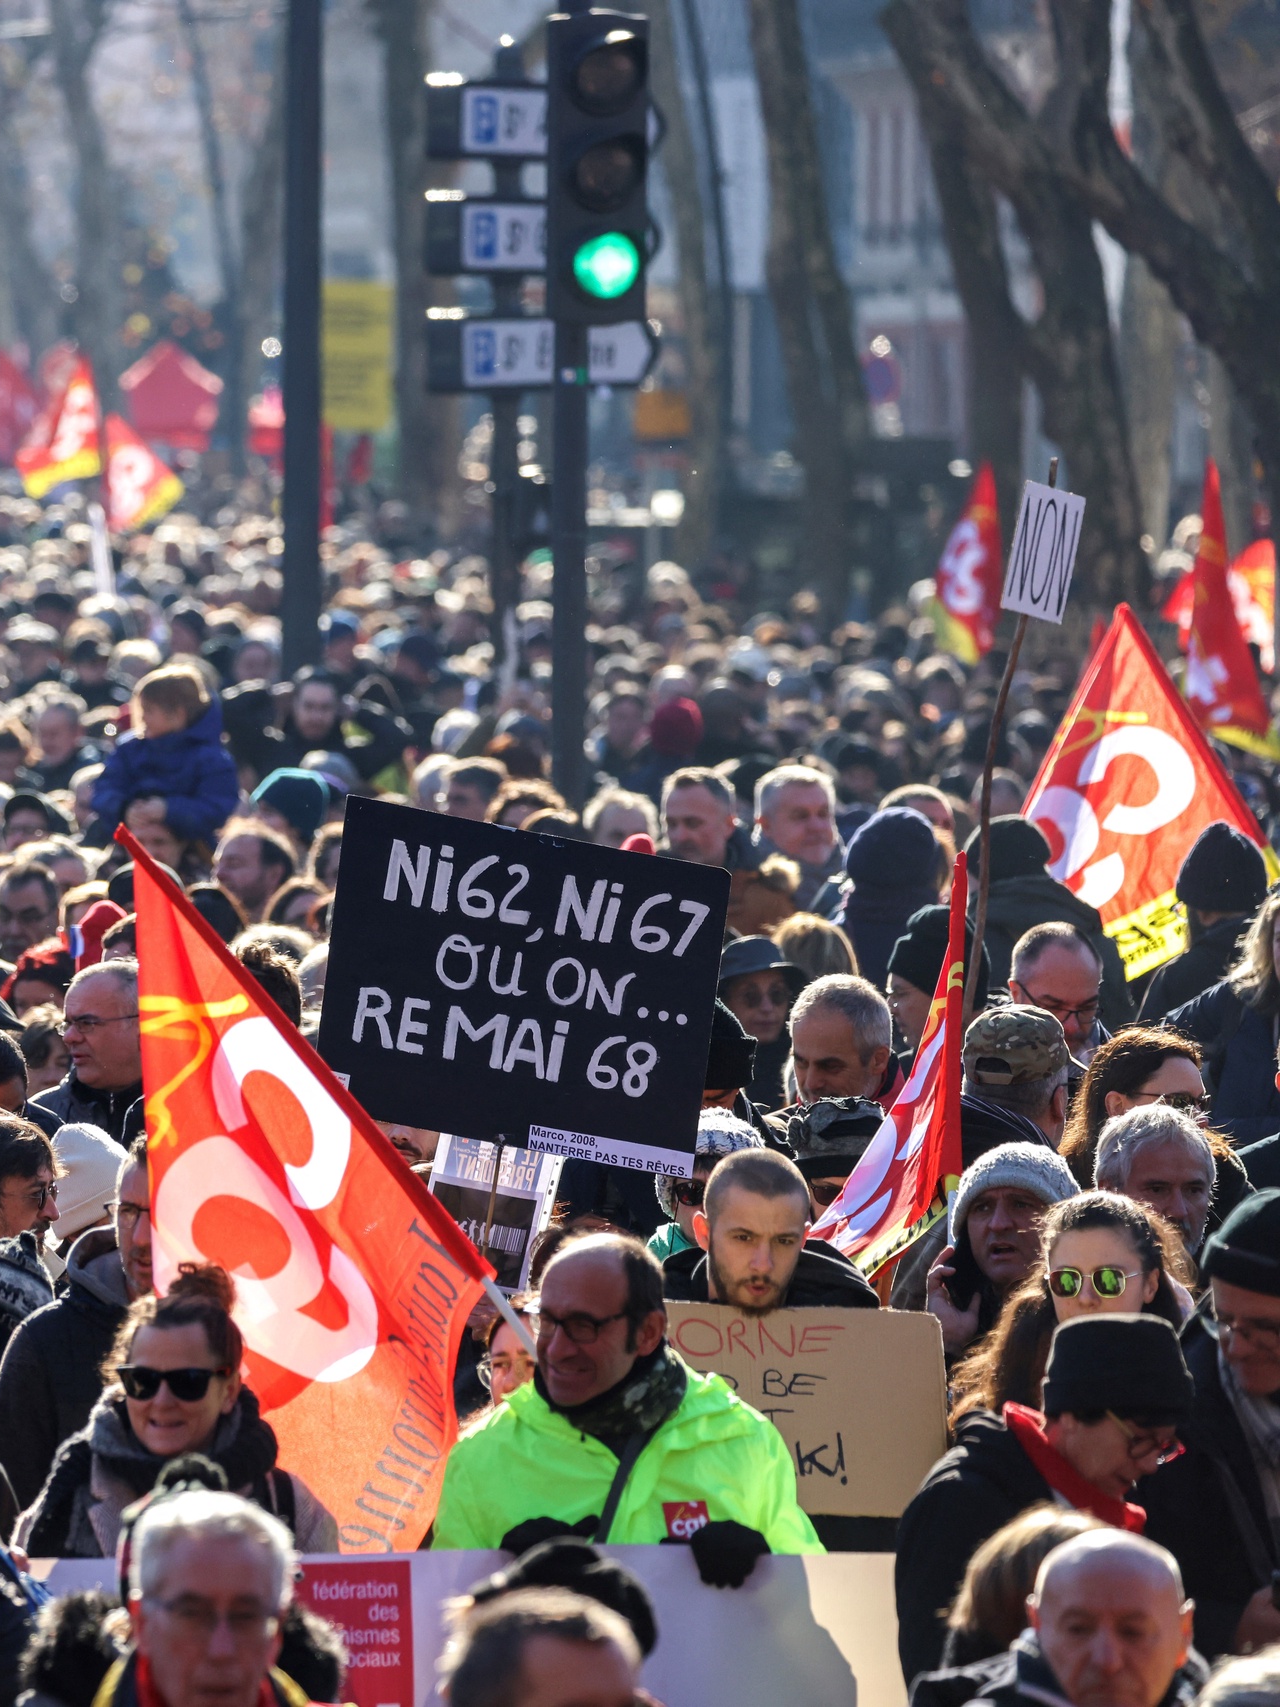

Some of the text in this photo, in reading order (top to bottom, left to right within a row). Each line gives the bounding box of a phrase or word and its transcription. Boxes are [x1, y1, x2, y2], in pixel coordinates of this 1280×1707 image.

[1008, 495, 1079, 616] NON
[586, 1035, 658, 1098] 68
[531, 1126, 598, 1149] Marco, 2008,
[529, 1139, 592, 1160] NANTERRE
[594, 1151, 618, 1165] PAS
[621, 1156, 643, 1169] TES
[646, 1160, 688, 1177] RÊVES.
[669, 1318, 846, 1360] ORNE
[762, 1369, 827, 1397] BE
[313, 1580, 399, 1601] fédération
[368, 1603, 400, 1623] des
[346, 1649, 401, 1669] ociaux
